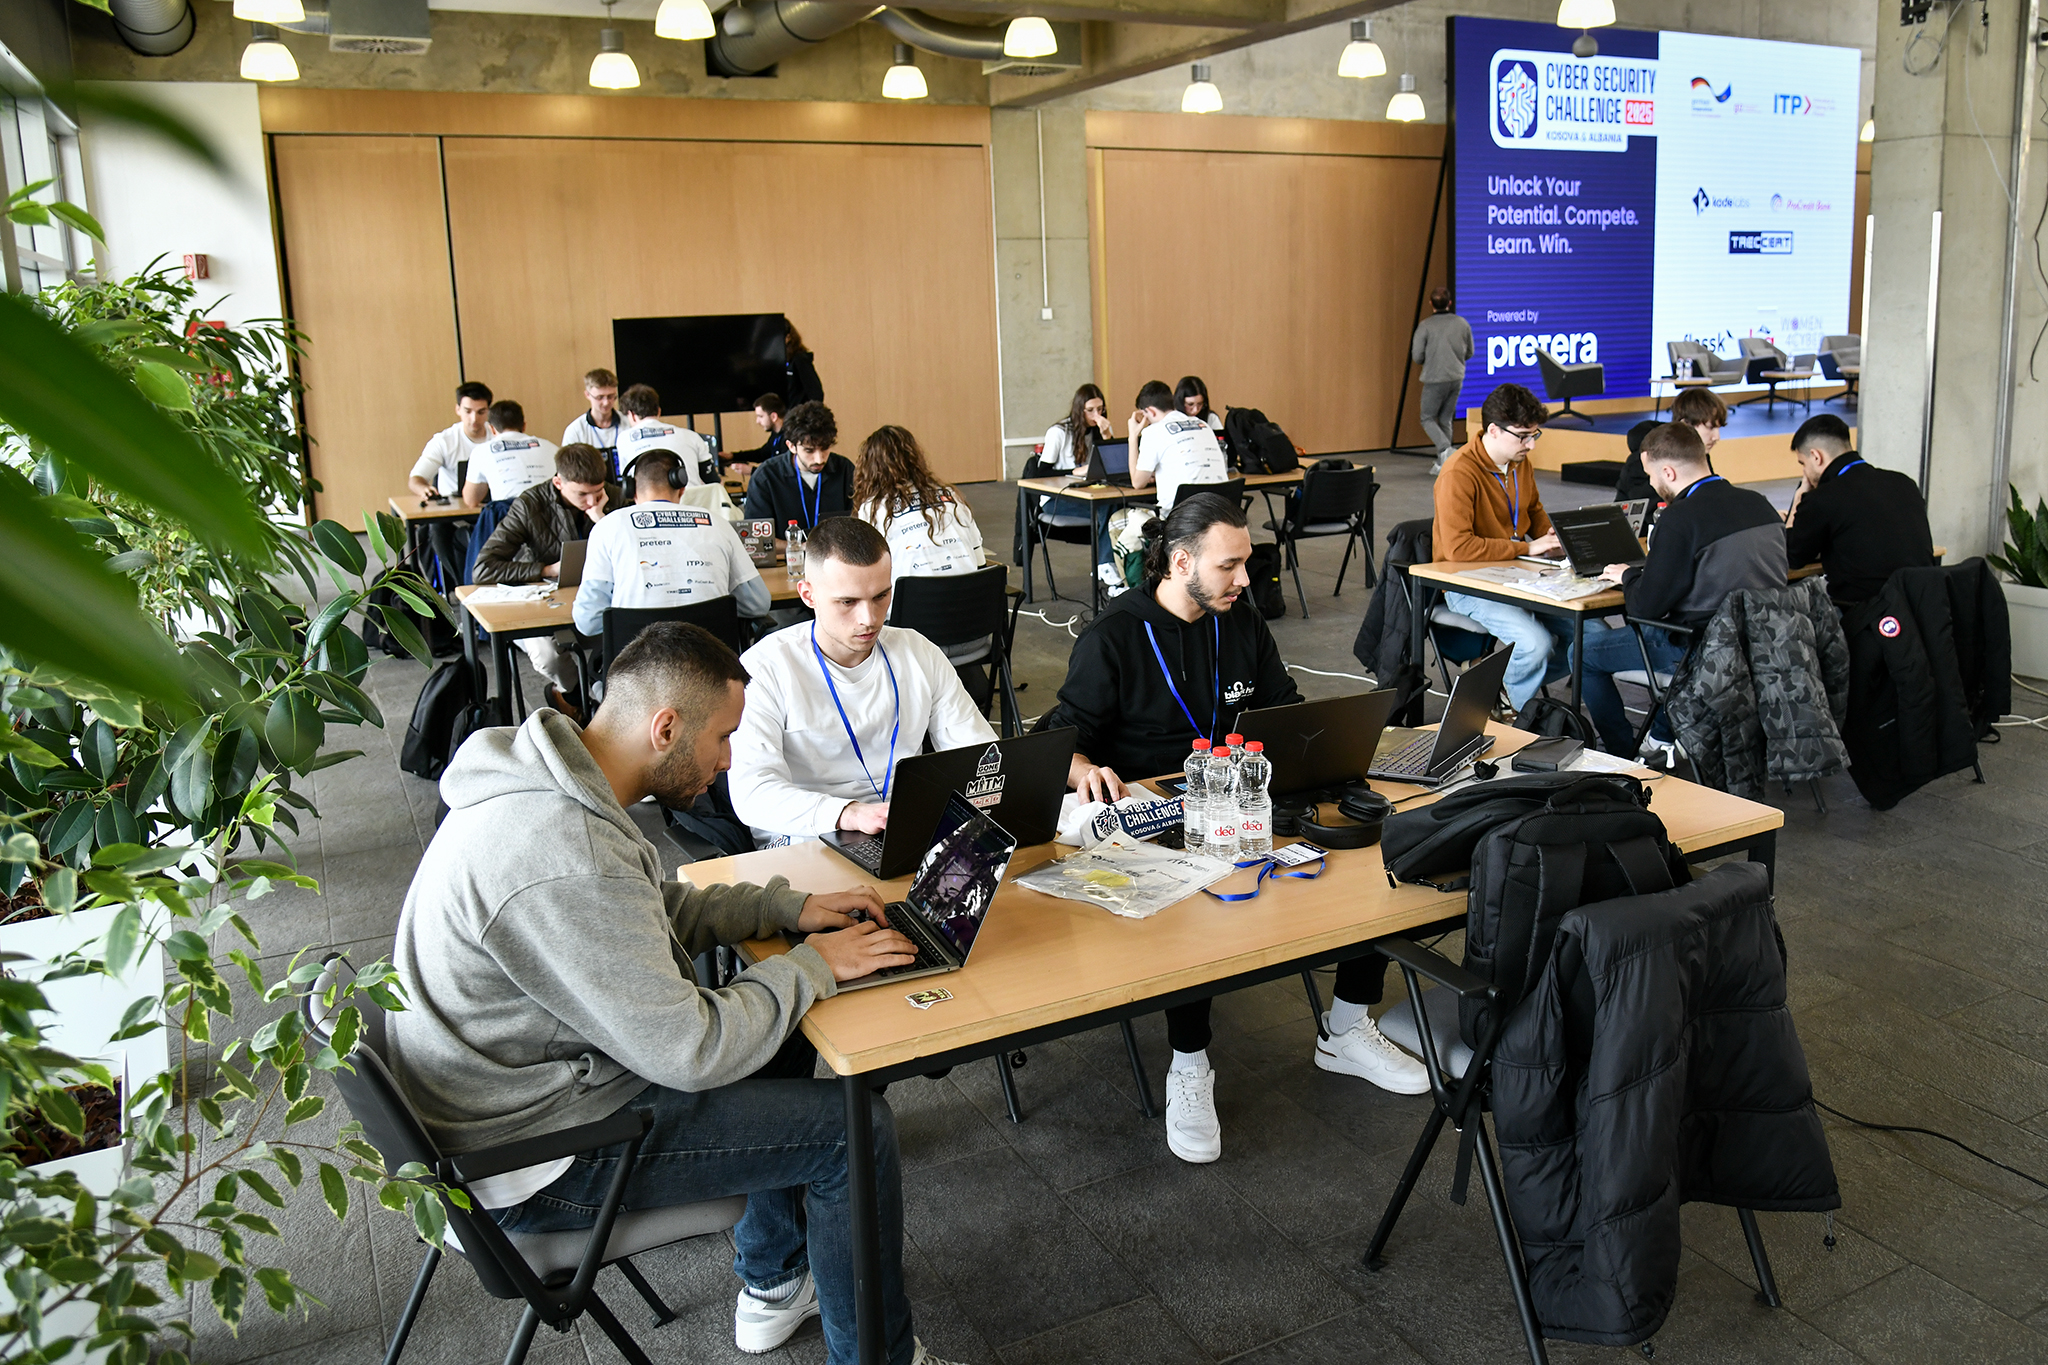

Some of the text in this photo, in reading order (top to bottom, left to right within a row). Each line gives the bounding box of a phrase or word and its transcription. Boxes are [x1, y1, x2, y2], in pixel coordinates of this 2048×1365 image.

[1546, 62, 1657, 94] CYBER SECURITY
[1546, 95, 1653, 124] CHALLENGE 2025
[1773, 93, 1802, 115] ITP
[1546, 131, 1579, 141] KOSOVA
[1588, 133, 1623, 143] ALBANIA
[1487, 174, 1582, 197] Unlock Your
[1487, 203, 1640, 232] Potential. Compete.
[1487, 232, 1574, 255] Learn. Win.
[1487, 309, 1539, 324] Powered by
[753, 522, 772, 537] 50
[901, 521, 928, 535] pretera
[640, 540, 672, 548] pretera
[978, 763, 999, 772] GONE
[1125, 802, 1183, 828] CHALLENGE
[1130, 825, 1156, 836] KOSOVA
[1214, 826, 1235, 837] dea
[1242, 820, 1263, 831] dea
